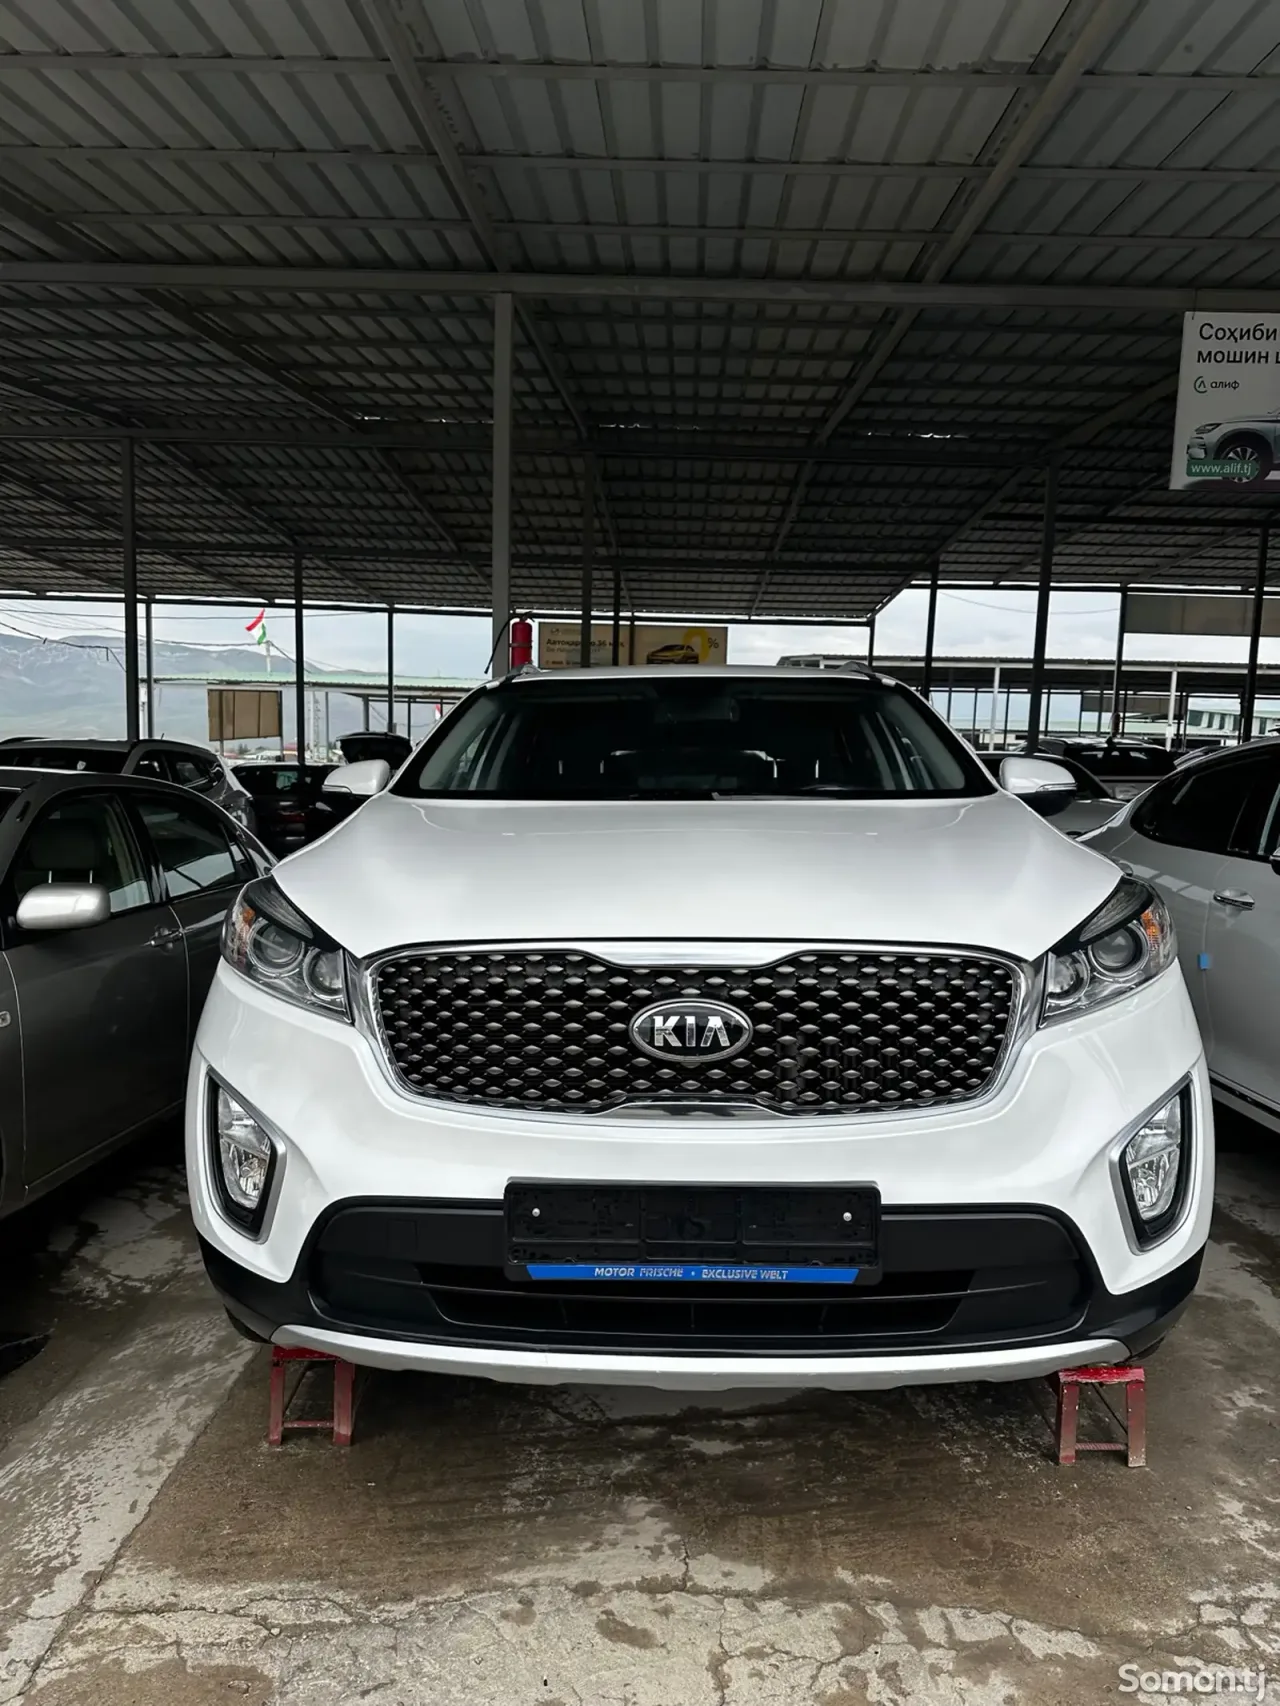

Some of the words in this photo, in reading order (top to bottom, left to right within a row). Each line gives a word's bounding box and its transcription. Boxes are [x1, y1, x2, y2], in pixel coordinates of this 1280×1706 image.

[1199, 322, 1277, 343] Соҳиби
[1196, 350, 1269, 364] мошин
[1210, 379, 1240, 390] алиф
[1191, 462, 1252, 475] www.alif.tj
[653, 1015, 731, 1047] KIA
[594, 1267, 635, 1277] MOTOR
[639, 1268, 684, 1278] FRISCHE
[702, 1269, 758, 1279] EXCLUSIVE
[760, 1270, 789, 1280] WELT
